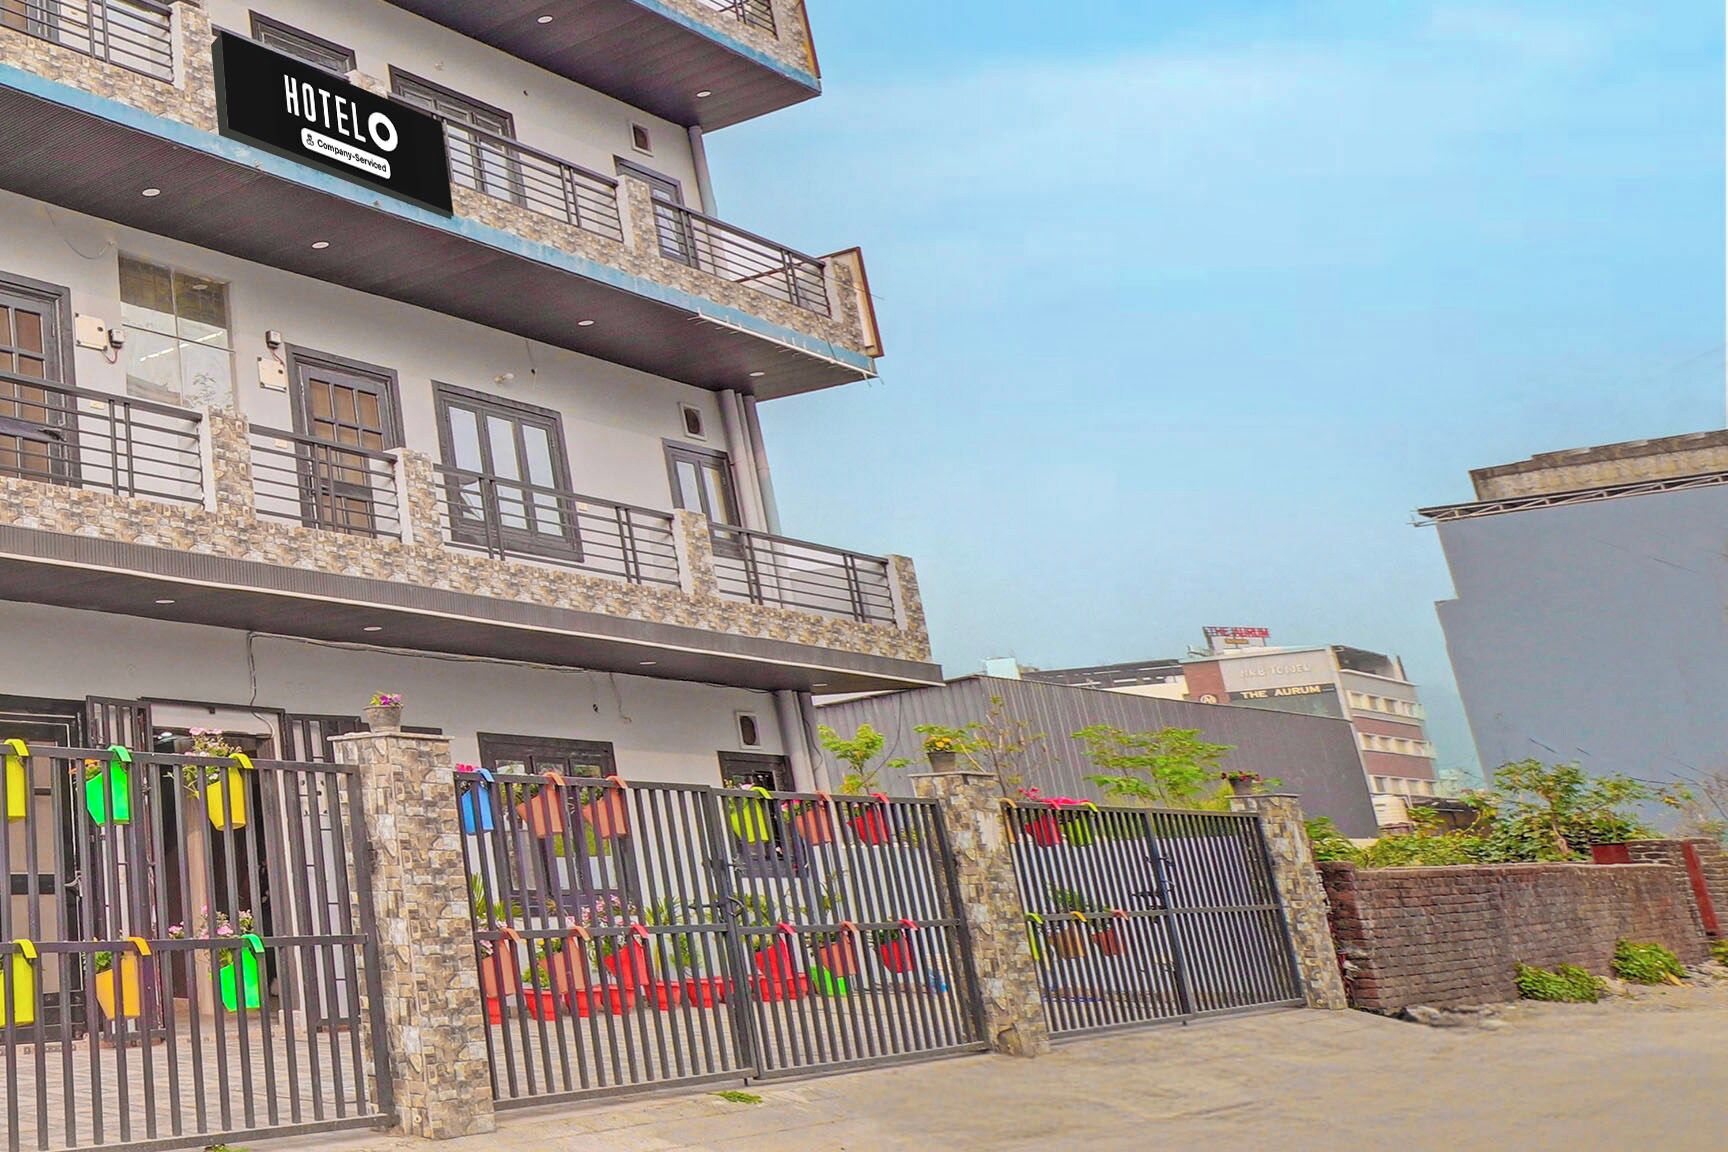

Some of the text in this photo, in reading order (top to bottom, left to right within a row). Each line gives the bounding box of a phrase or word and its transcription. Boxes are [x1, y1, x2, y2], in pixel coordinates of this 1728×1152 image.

[283, 74, 367, 143] HOTEL
[317, 138, 387, 172] Company-Serviced
[1240, 685, 1321, 699] THE AURUM
